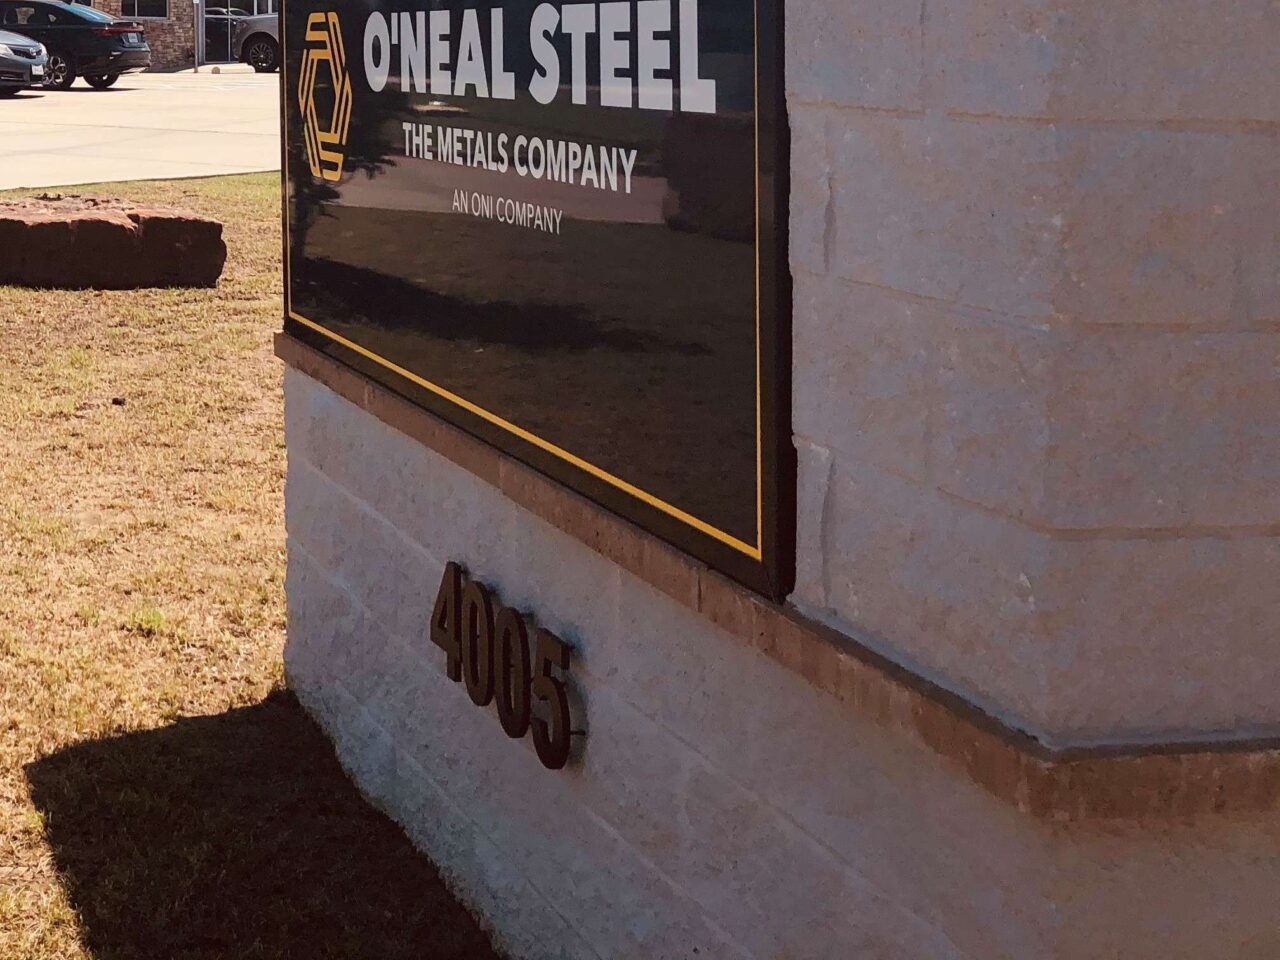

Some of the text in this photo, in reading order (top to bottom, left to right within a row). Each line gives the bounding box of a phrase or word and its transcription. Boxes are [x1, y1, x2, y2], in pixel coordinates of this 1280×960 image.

[363, 7, 516, 100] O'NEAL
[402, 122, 638, 194] THE METALS COMPANY
[452, 189, 563, 235] AN ONI COMPANY
[430, 561, 574, 770] 4005
